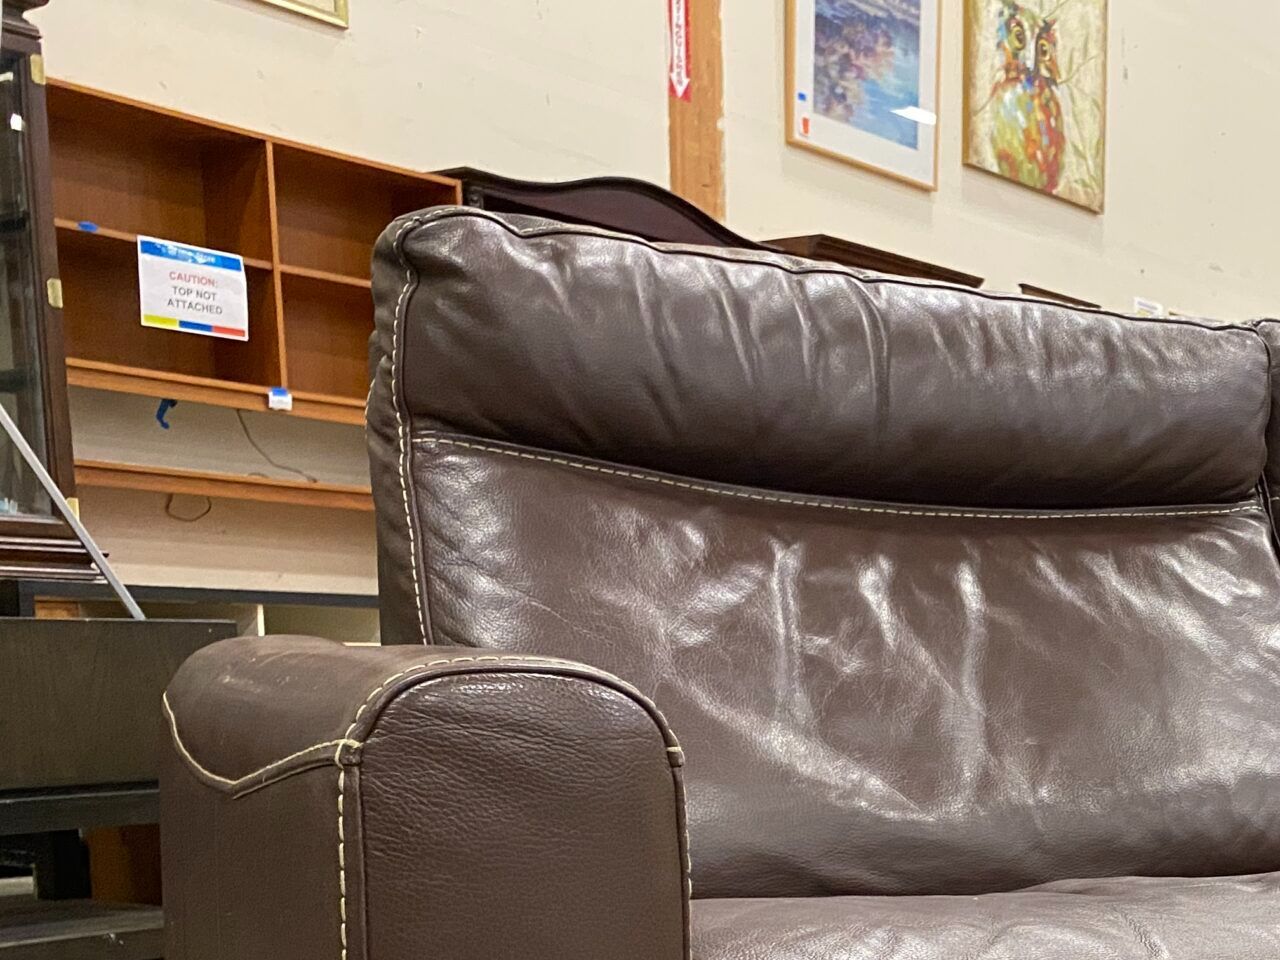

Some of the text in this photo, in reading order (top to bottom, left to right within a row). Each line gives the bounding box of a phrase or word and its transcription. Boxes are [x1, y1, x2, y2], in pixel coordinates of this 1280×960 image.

[169, 271, 218, 287] CAUTION:
[172, 286, 217, 301] TOP NOT
[167, 298, 223, 315] ATTACHED
